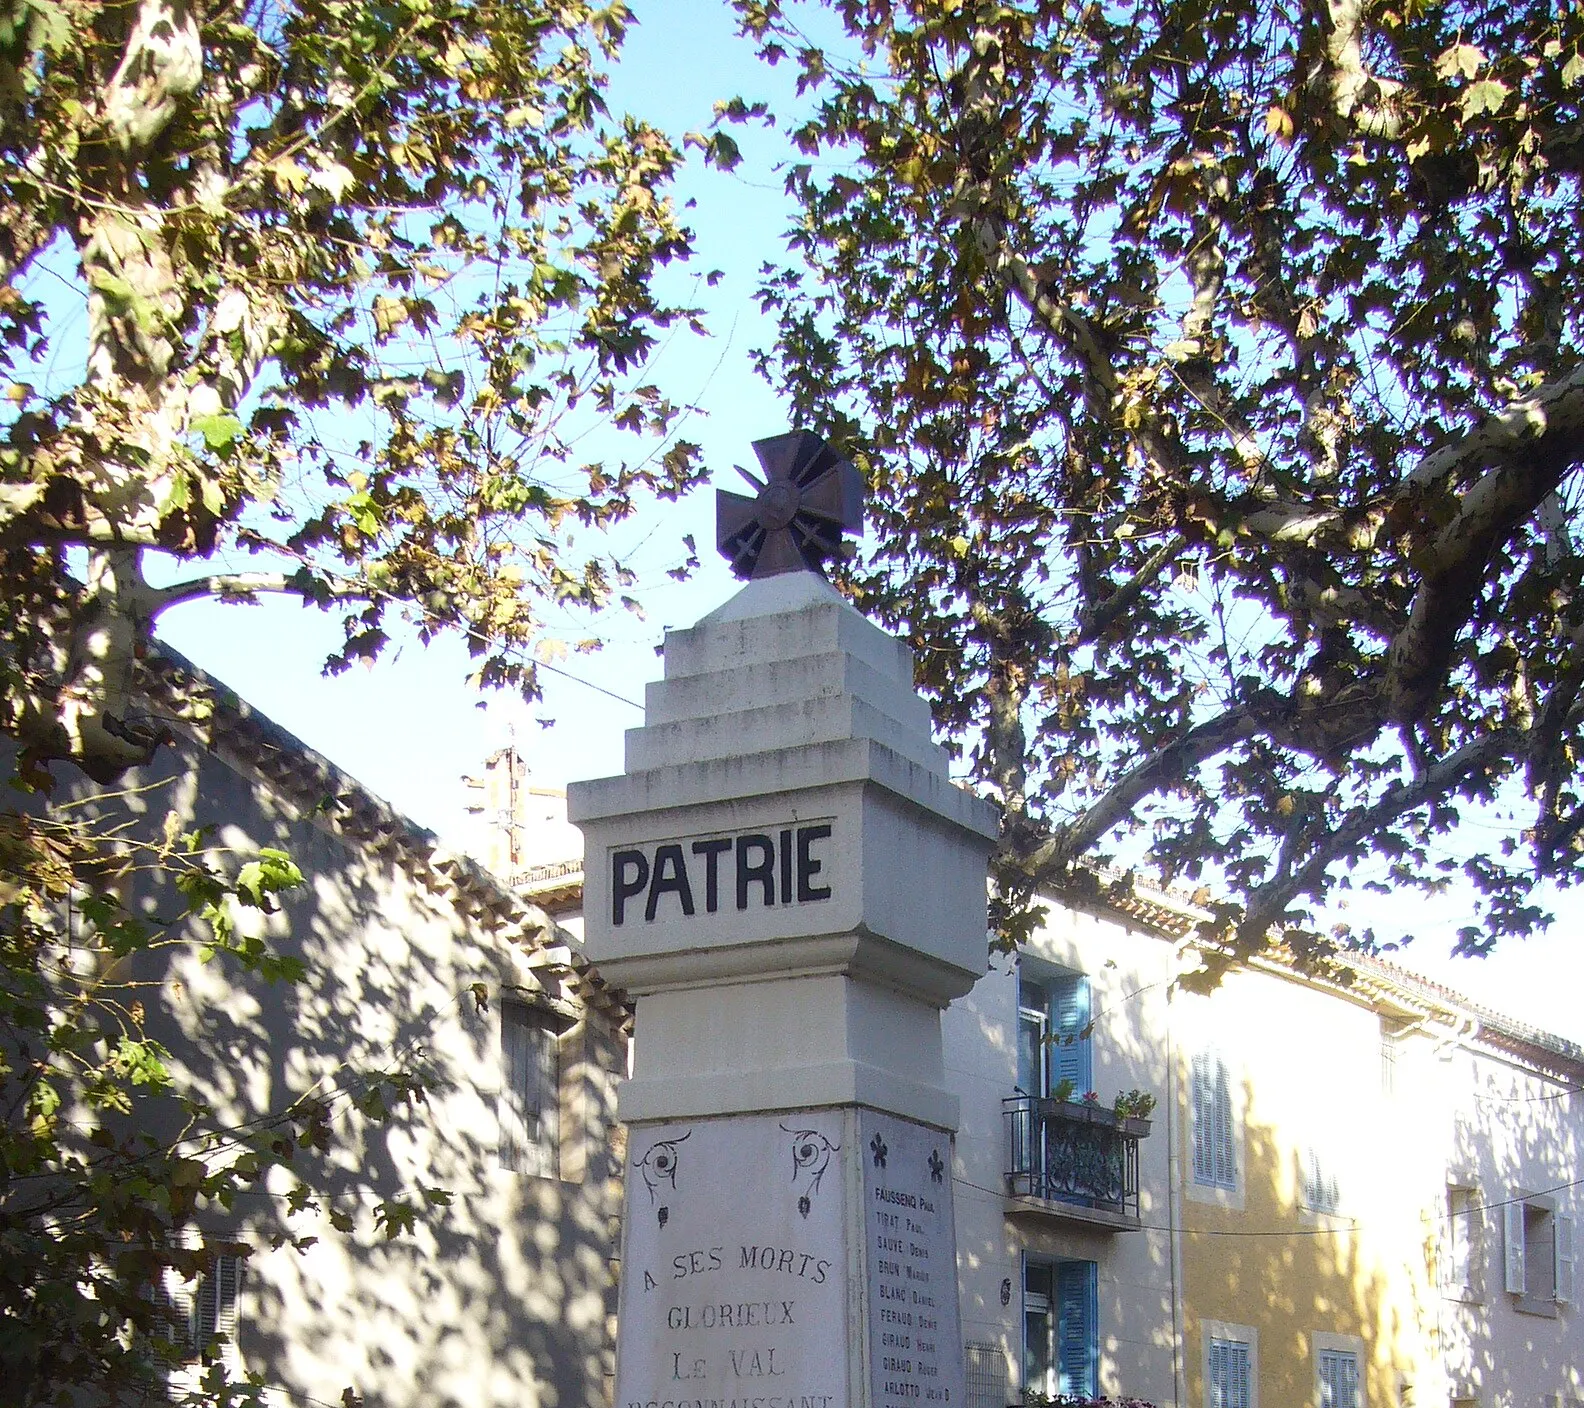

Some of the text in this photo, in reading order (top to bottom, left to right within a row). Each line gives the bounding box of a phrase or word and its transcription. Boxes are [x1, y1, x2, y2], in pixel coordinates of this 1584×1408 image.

[613, 824, 832, 925] PATRIE
[644, 1246, 833, 1293] A SES MORTS
[879, 1260, 900, 1277] BRUN
[880, 1285, 906, 1302] BLANC
[667, 1301, 796, 1330] GLORIEUX
[728, 1348, 786, 1377] VAL
[883, 1357, 912, 1373] GIRAUD
[884, 1381, 920, 1398] ARLOTTO
